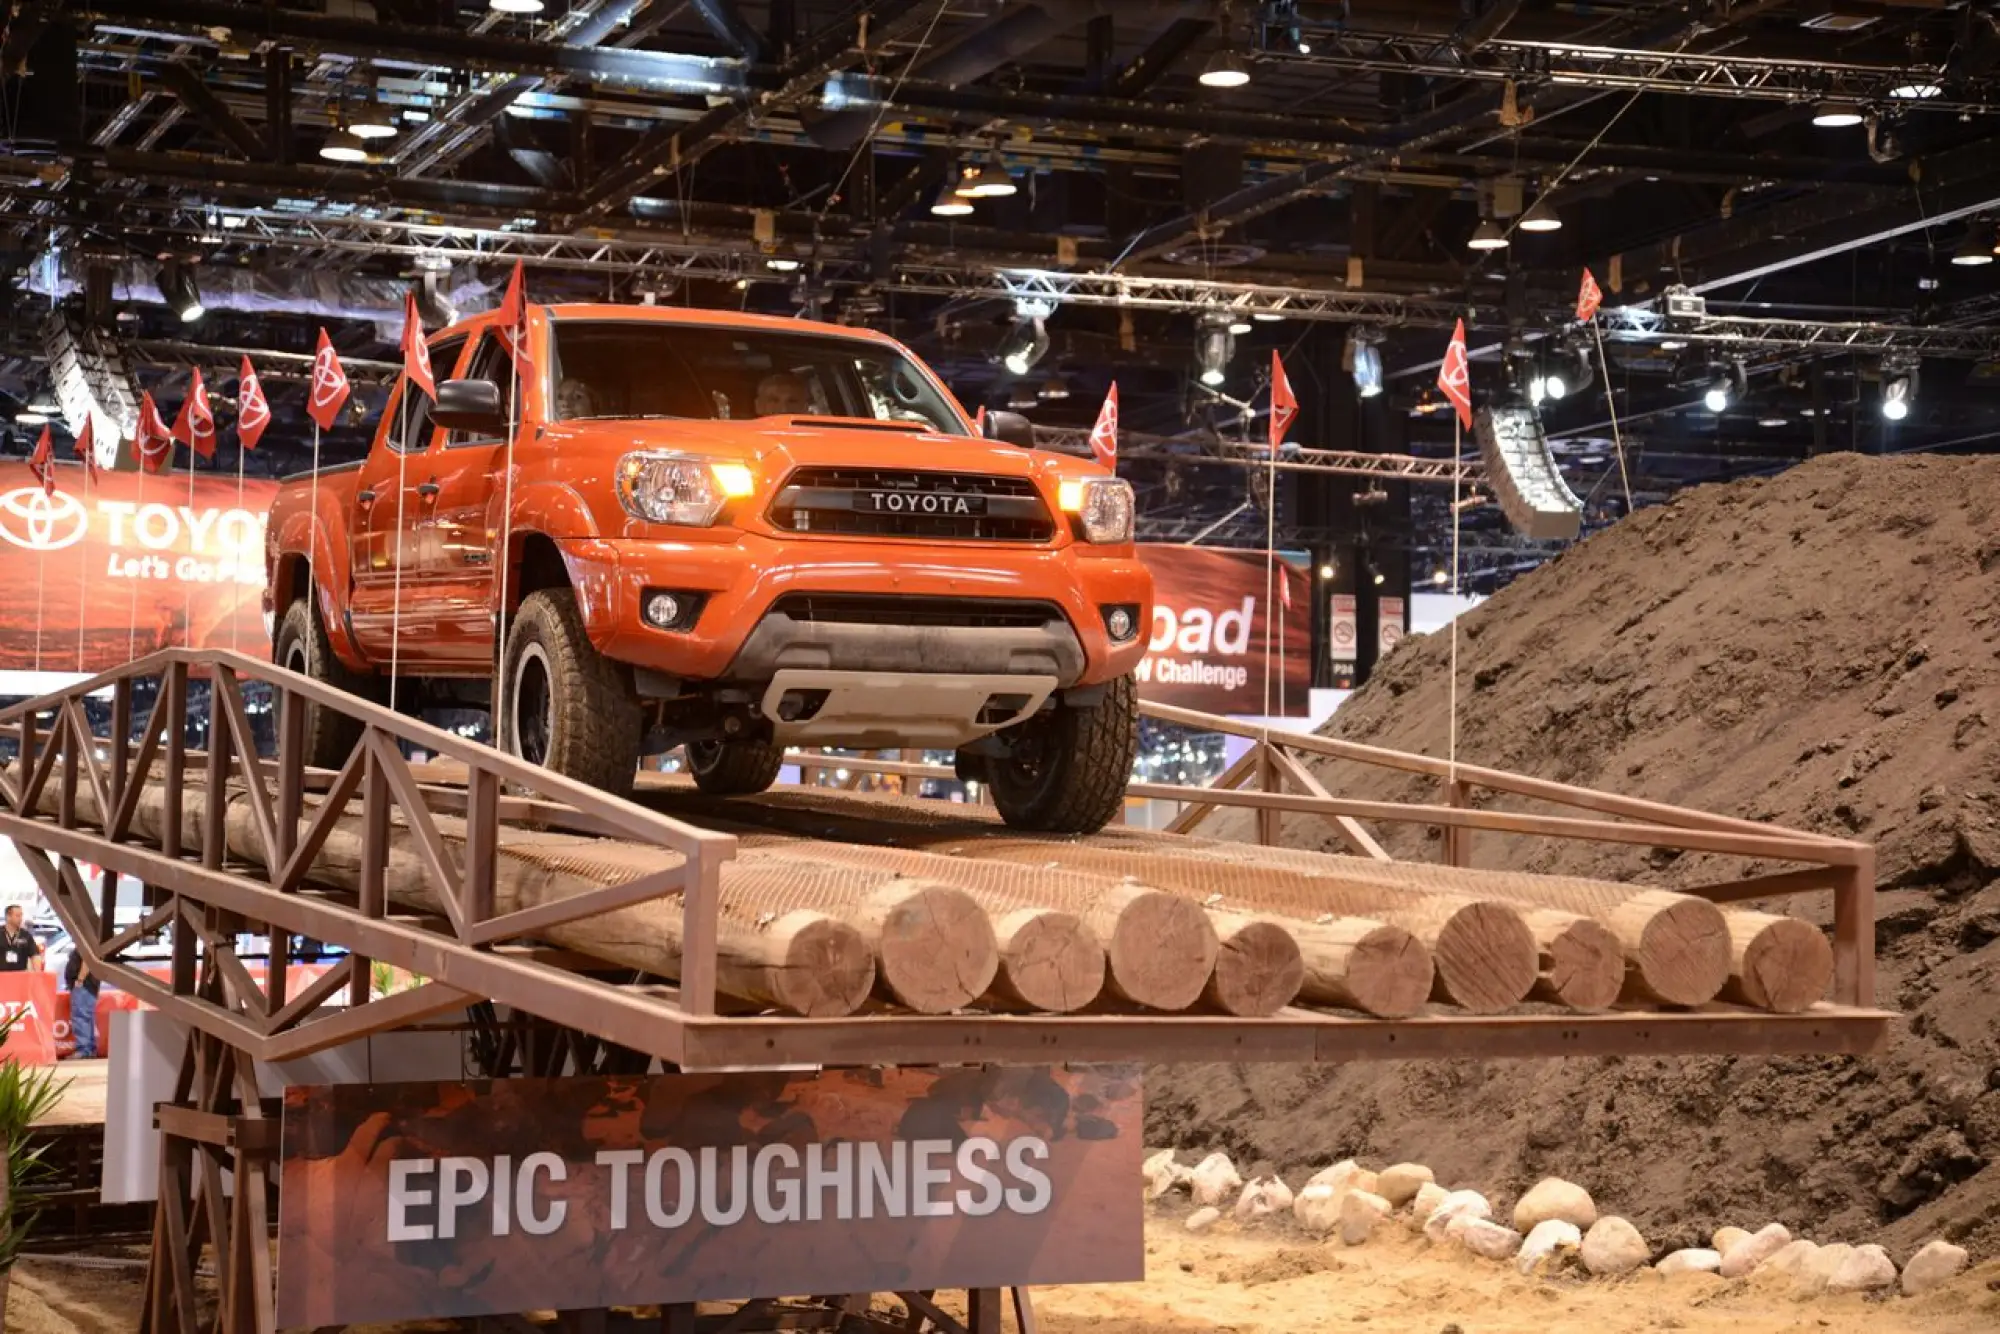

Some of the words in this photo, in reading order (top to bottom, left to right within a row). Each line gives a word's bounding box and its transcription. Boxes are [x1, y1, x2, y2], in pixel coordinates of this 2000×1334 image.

[871, 492, 970, 515] TOYOTA
[97, 500, 268, 554] TOYO
[108, 552, 169, 579] Let's
[1155, 657, 1248, 692] Challenge
[386, 1150, 567, 1242] EPIC
[595, 1135, 1052, 1230] TOUGHNESS
